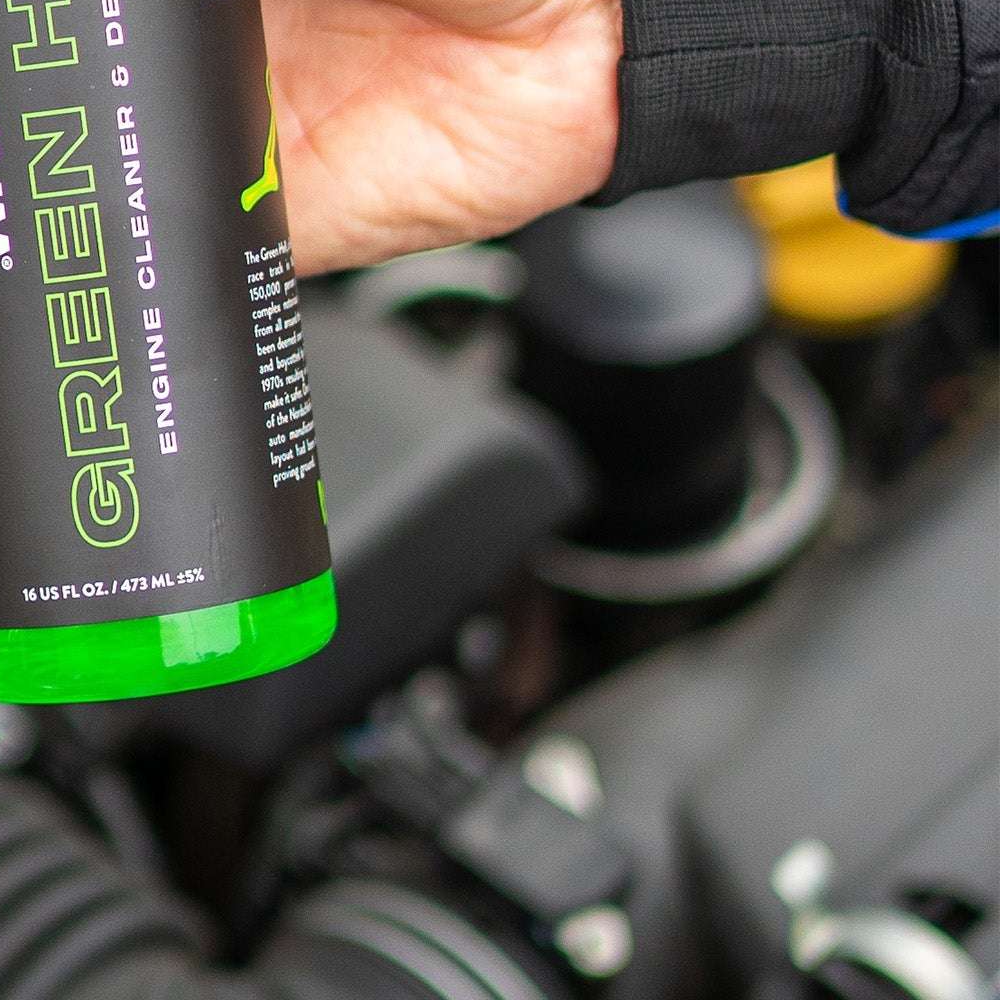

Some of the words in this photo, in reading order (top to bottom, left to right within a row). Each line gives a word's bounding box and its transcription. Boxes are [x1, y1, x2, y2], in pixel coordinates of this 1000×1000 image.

[111, 64, 130, 87] &
[116, 105, 156, 290] CLEANER
[244, 251, 260, 265] The
[260, 247, 279, 261] Green
[247, 272, 264, 284] race
[269, 261, 284, 278] track
[249, 281, 280, 301] 150,000
[252, 301, 281, 320] complex
[21, 105, 139, 549] GREEN
[254, 324, 273, 338] from
[256, 343, 275, 356] been
[259, 358, 274, 374] and
[142, 307, 179, 455] ENGINE
[261, 376, 283, 392] 1970s
[263, 394, 284, 411] make
[266, 413, 275, 428] of
[277, 411, 288, 426] the
[269, 434, 286, 447] auto
[270, 449, 294, 468] layout
[273, 465, 300, 488] proving
[22, 588, 38, 602] 16
[39, 586, 60, 601] US
[61, 584, 81, 600] FL
[81, 581, 110, 597] OZ.
[111, 579, 118, 595] /
[120, 576, 149, 593] 473
[151, 573, 176, 589] ML
[177, 566, 206, 585] ±5%
